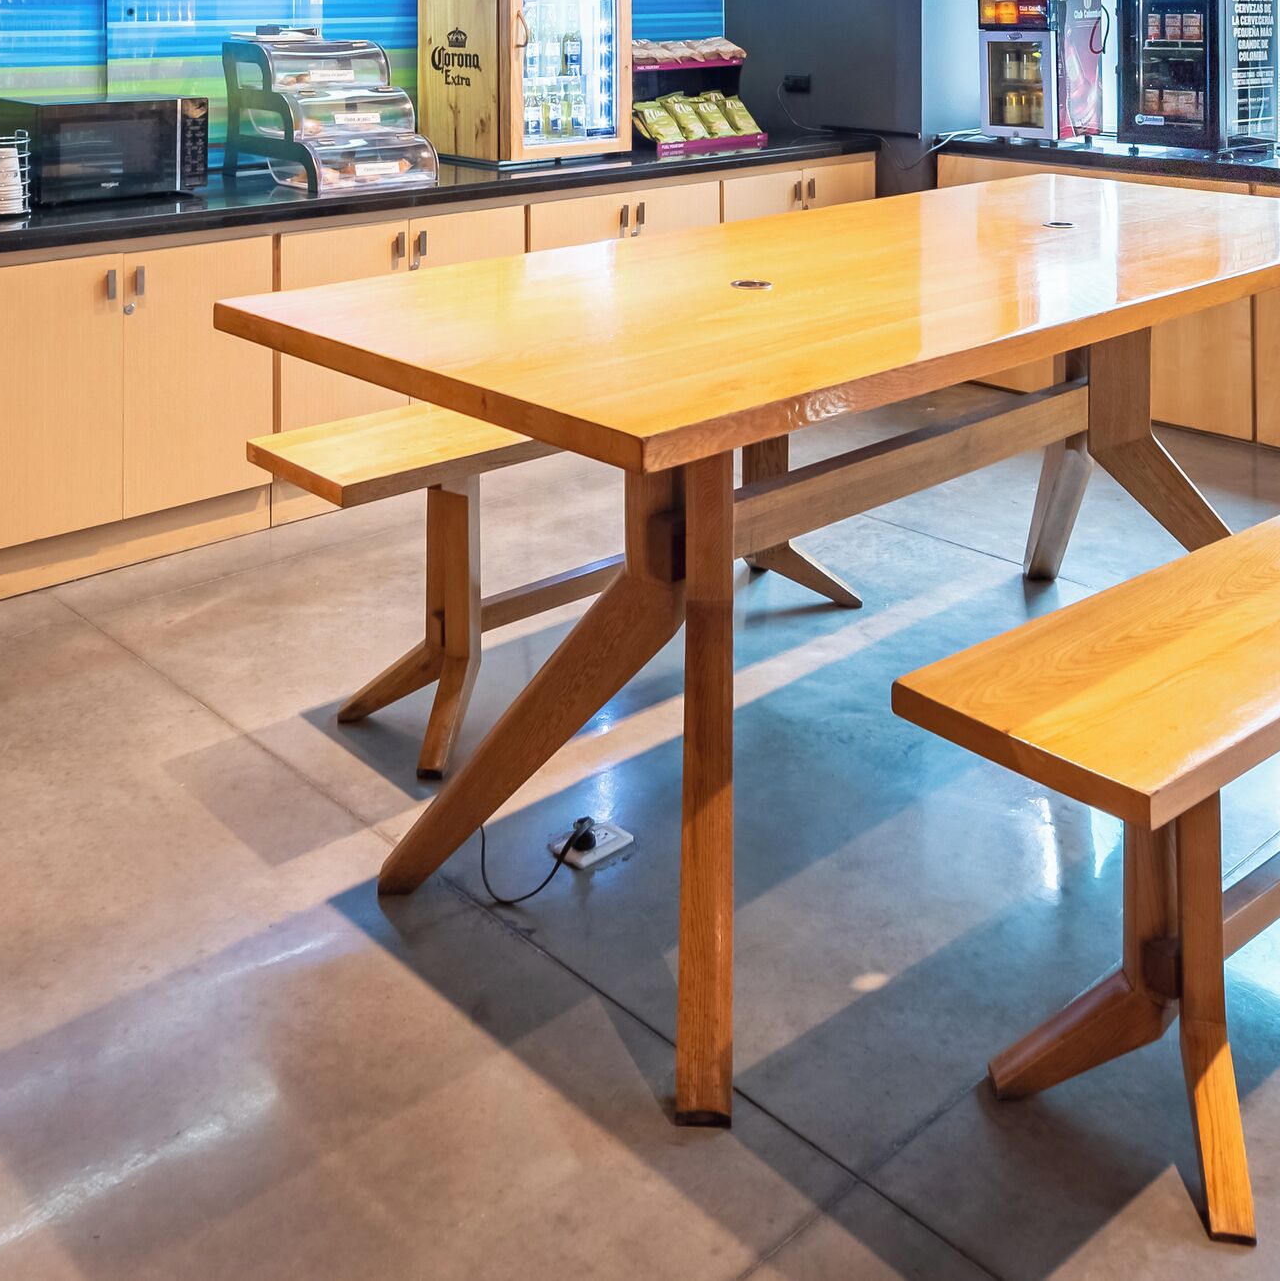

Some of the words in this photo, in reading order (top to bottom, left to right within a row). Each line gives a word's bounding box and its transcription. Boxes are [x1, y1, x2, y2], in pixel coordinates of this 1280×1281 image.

[1234, 3, 1263, 14] CERVEZAS
[1264, 3, 1272, 14] DE
[1231, 15, 1240, 26] LA
[1238, 39, 1261, 50] GRANDE
[1261, 39, 1269, 49] DE
[431, 45, 482, 74] Corona
[1238, 51, 1268, 62] COLOMBIA
[444, 68, 471, 87] Extra
